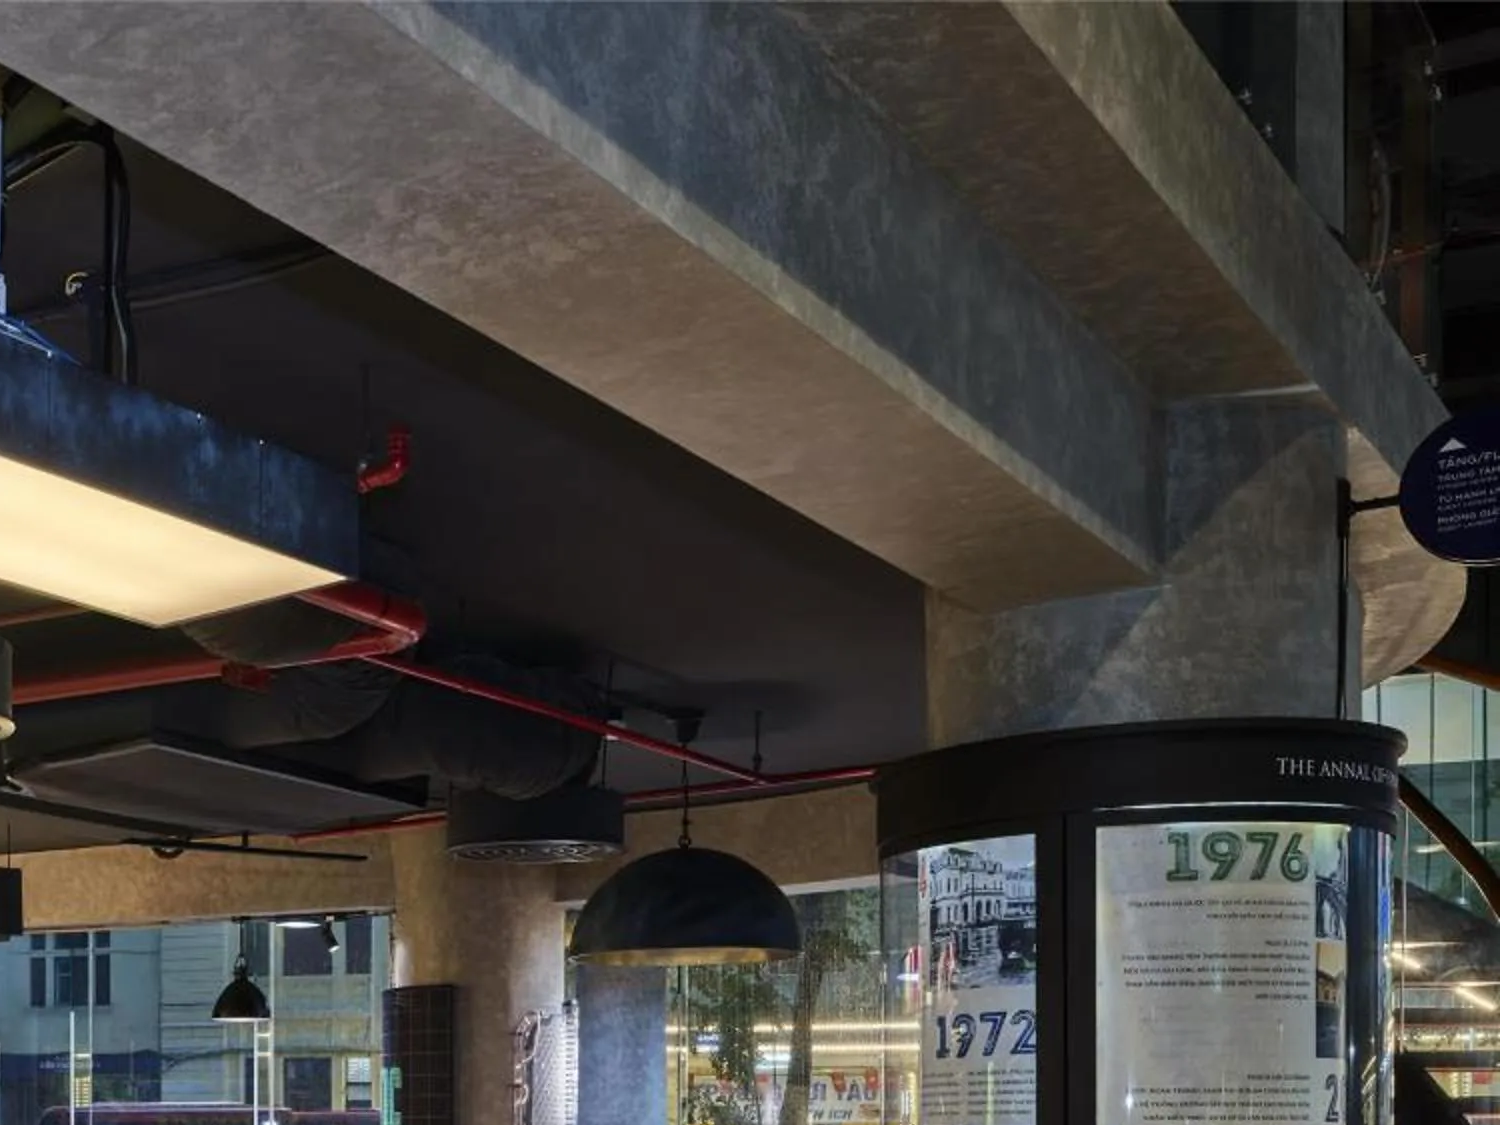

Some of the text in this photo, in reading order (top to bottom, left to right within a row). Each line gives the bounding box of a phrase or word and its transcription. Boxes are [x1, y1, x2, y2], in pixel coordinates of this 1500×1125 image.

[1276, 756, 1316, 777] THE
[1167, 831, 1309, 882] 1976
[936, 1009, 1036, 1058] 1972
